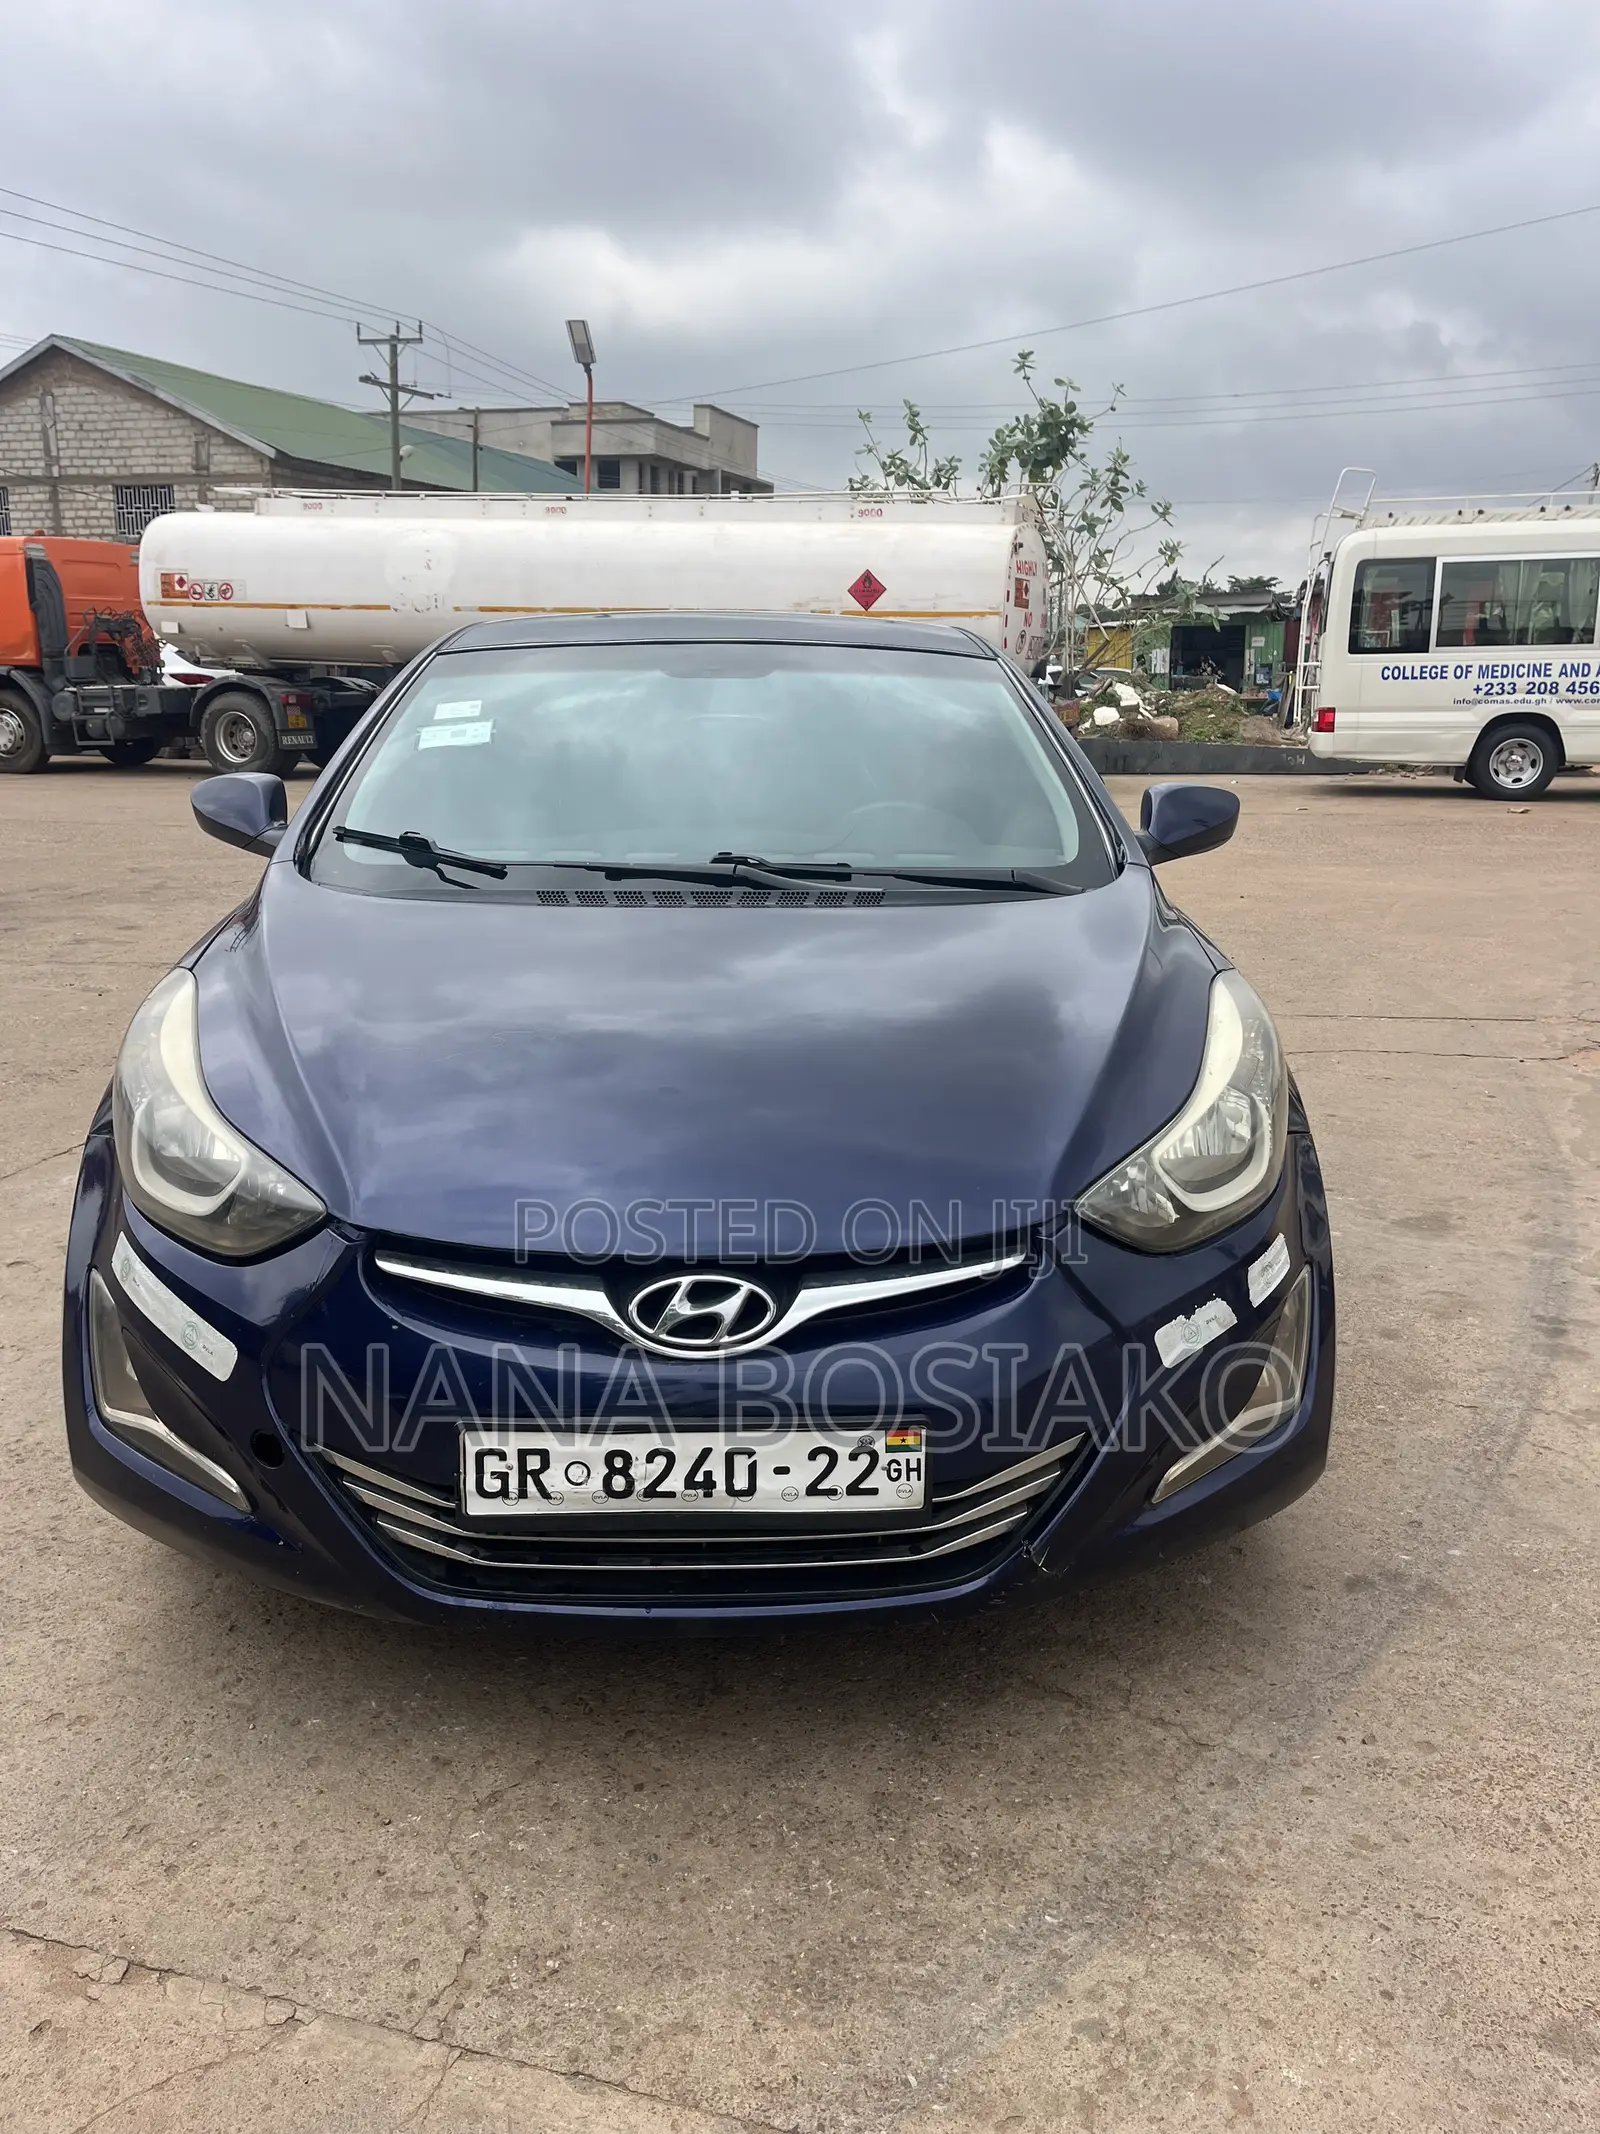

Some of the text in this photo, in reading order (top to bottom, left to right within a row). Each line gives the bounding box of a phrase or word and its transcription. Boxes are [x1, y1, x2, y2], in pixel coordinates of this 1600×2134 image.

[857, 508, 883, 518] 9000
[1024, 612, 1032, 628] NO
[1381, 665, 1449, 680] COLLEGE
[1453, 664, 1474, 680] OF
[1478, 663, 1552, 679] MEDICINE
[1558, 662, 1591, 678] AND
[1473, 681, 1600, 696] +233 208 456
[1453, 696, 1546, 706] info@comas.edu.gh
[282, 735, 314, 744] RENAULT
[475, 1448, 550, 1500] GR
[886, 1458, 922, 1482] GH
